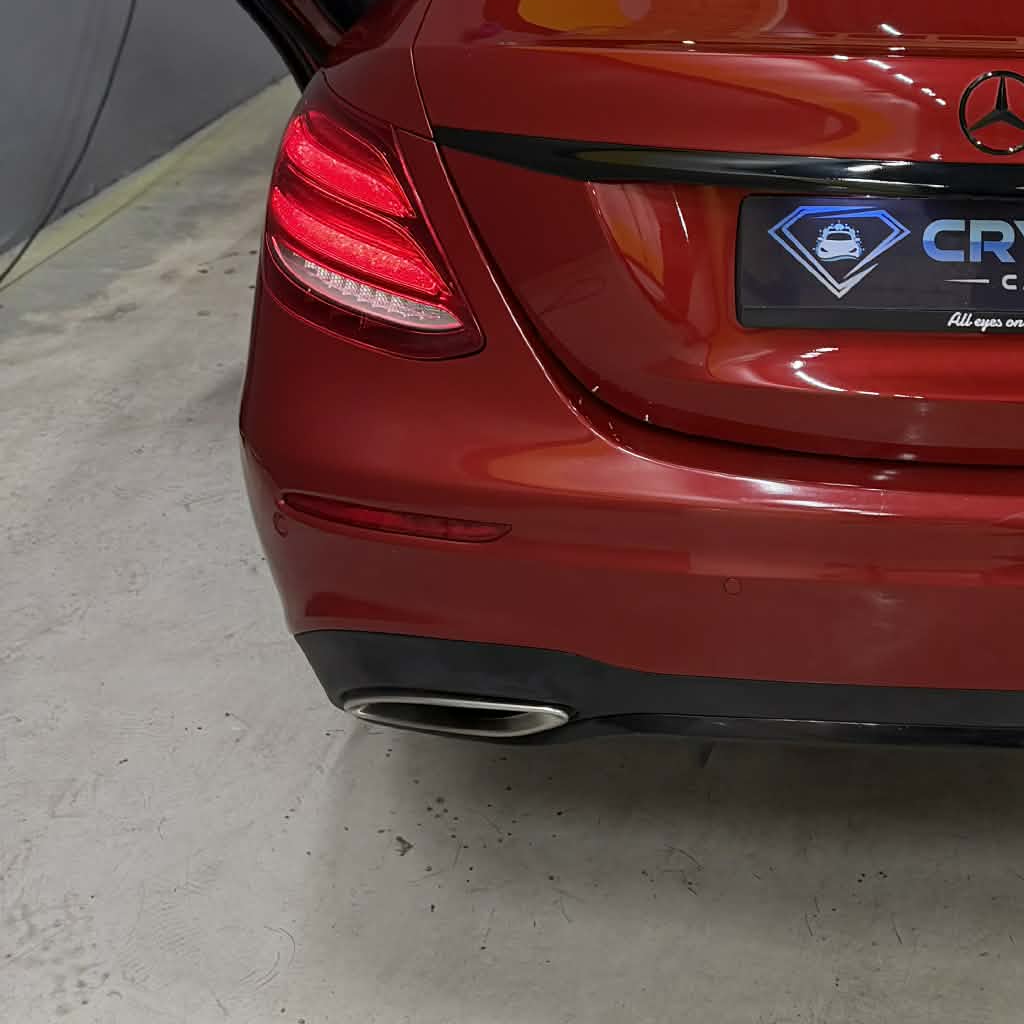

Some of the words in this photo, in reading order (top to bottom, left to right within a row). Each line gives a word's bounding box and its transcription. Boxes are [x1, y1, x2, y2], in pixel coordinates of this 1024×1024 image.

[947, 311, 973, 327] All
[974, 318, 1003, 332] eyes
[1005, 318, 1024, 328] on
